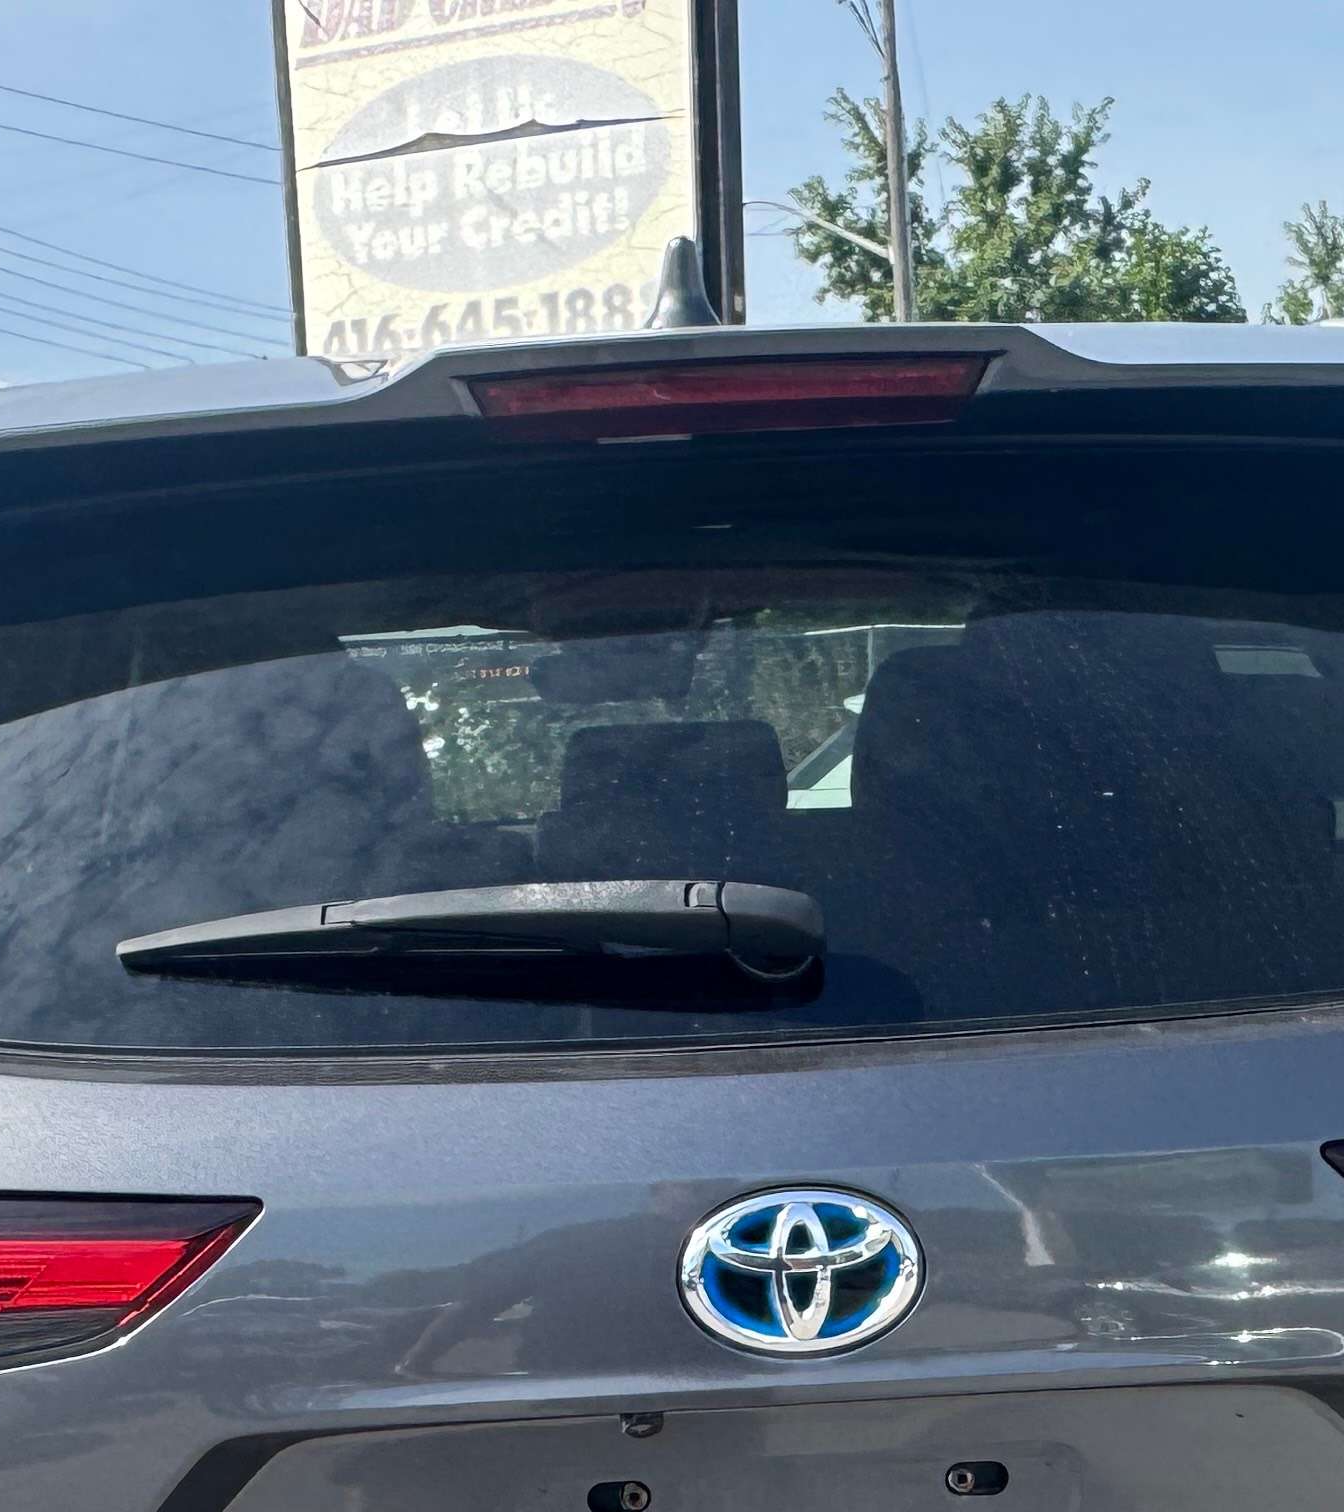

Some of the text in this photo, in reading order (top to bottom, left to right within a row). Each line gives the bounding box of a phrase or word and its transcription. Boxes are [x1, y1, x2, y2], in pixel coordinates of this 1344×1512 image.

[330, 126, 646, 218] Help Rebuild
[344, 186, 630, 265] Your Credit!
[323, 281, 658, 356] 416-645-188
